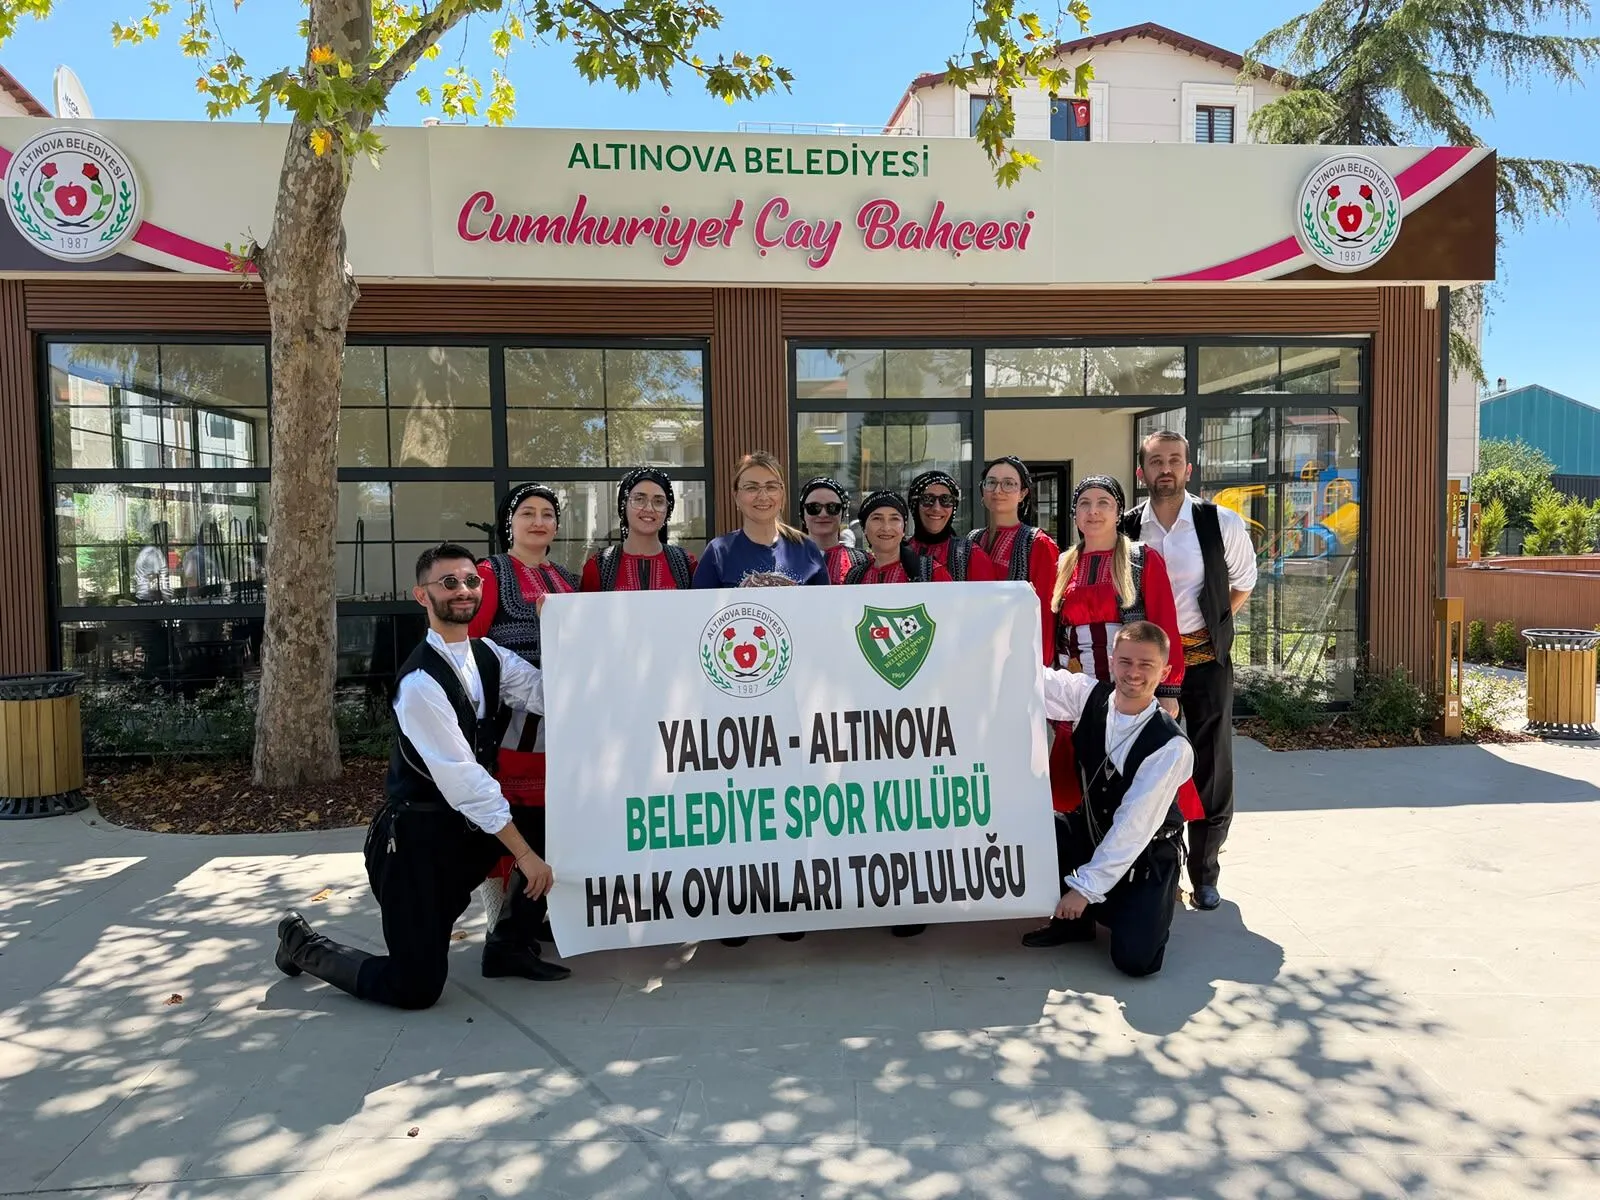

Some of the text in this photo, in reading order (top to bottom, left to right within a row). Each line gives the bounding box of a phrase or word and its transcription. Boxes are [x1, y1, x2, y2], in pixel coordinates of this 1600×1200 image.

[18, 137, 126, 180] ALTINOVA BELEDİYESİ
[567, 142, 929, 177] ALTINOVA BELEDİYESİ
[1310, 163, 1392, 199] ALTINOVA BELEDİYESİ
[60, 237, 89, 249] 1987
[456, 190, 1035, 270] Cumhuriyet Çay Bahçesi
[1340, 251, 1362, 261] 1987
[707, 607, 784, 640] ALTINOVA BELEDİYESİ
[737, 684, 759, 694] 1987
[658, 715, 781, 773] YALOVA
[809, 706, 956, 764] ALTINOVA
[626, 763, 992, 852] BELEDİYE SPOR KULÜBÜ
[585, 832, 1026, 928] HALK OYUNLARI TOPLULUĞU
